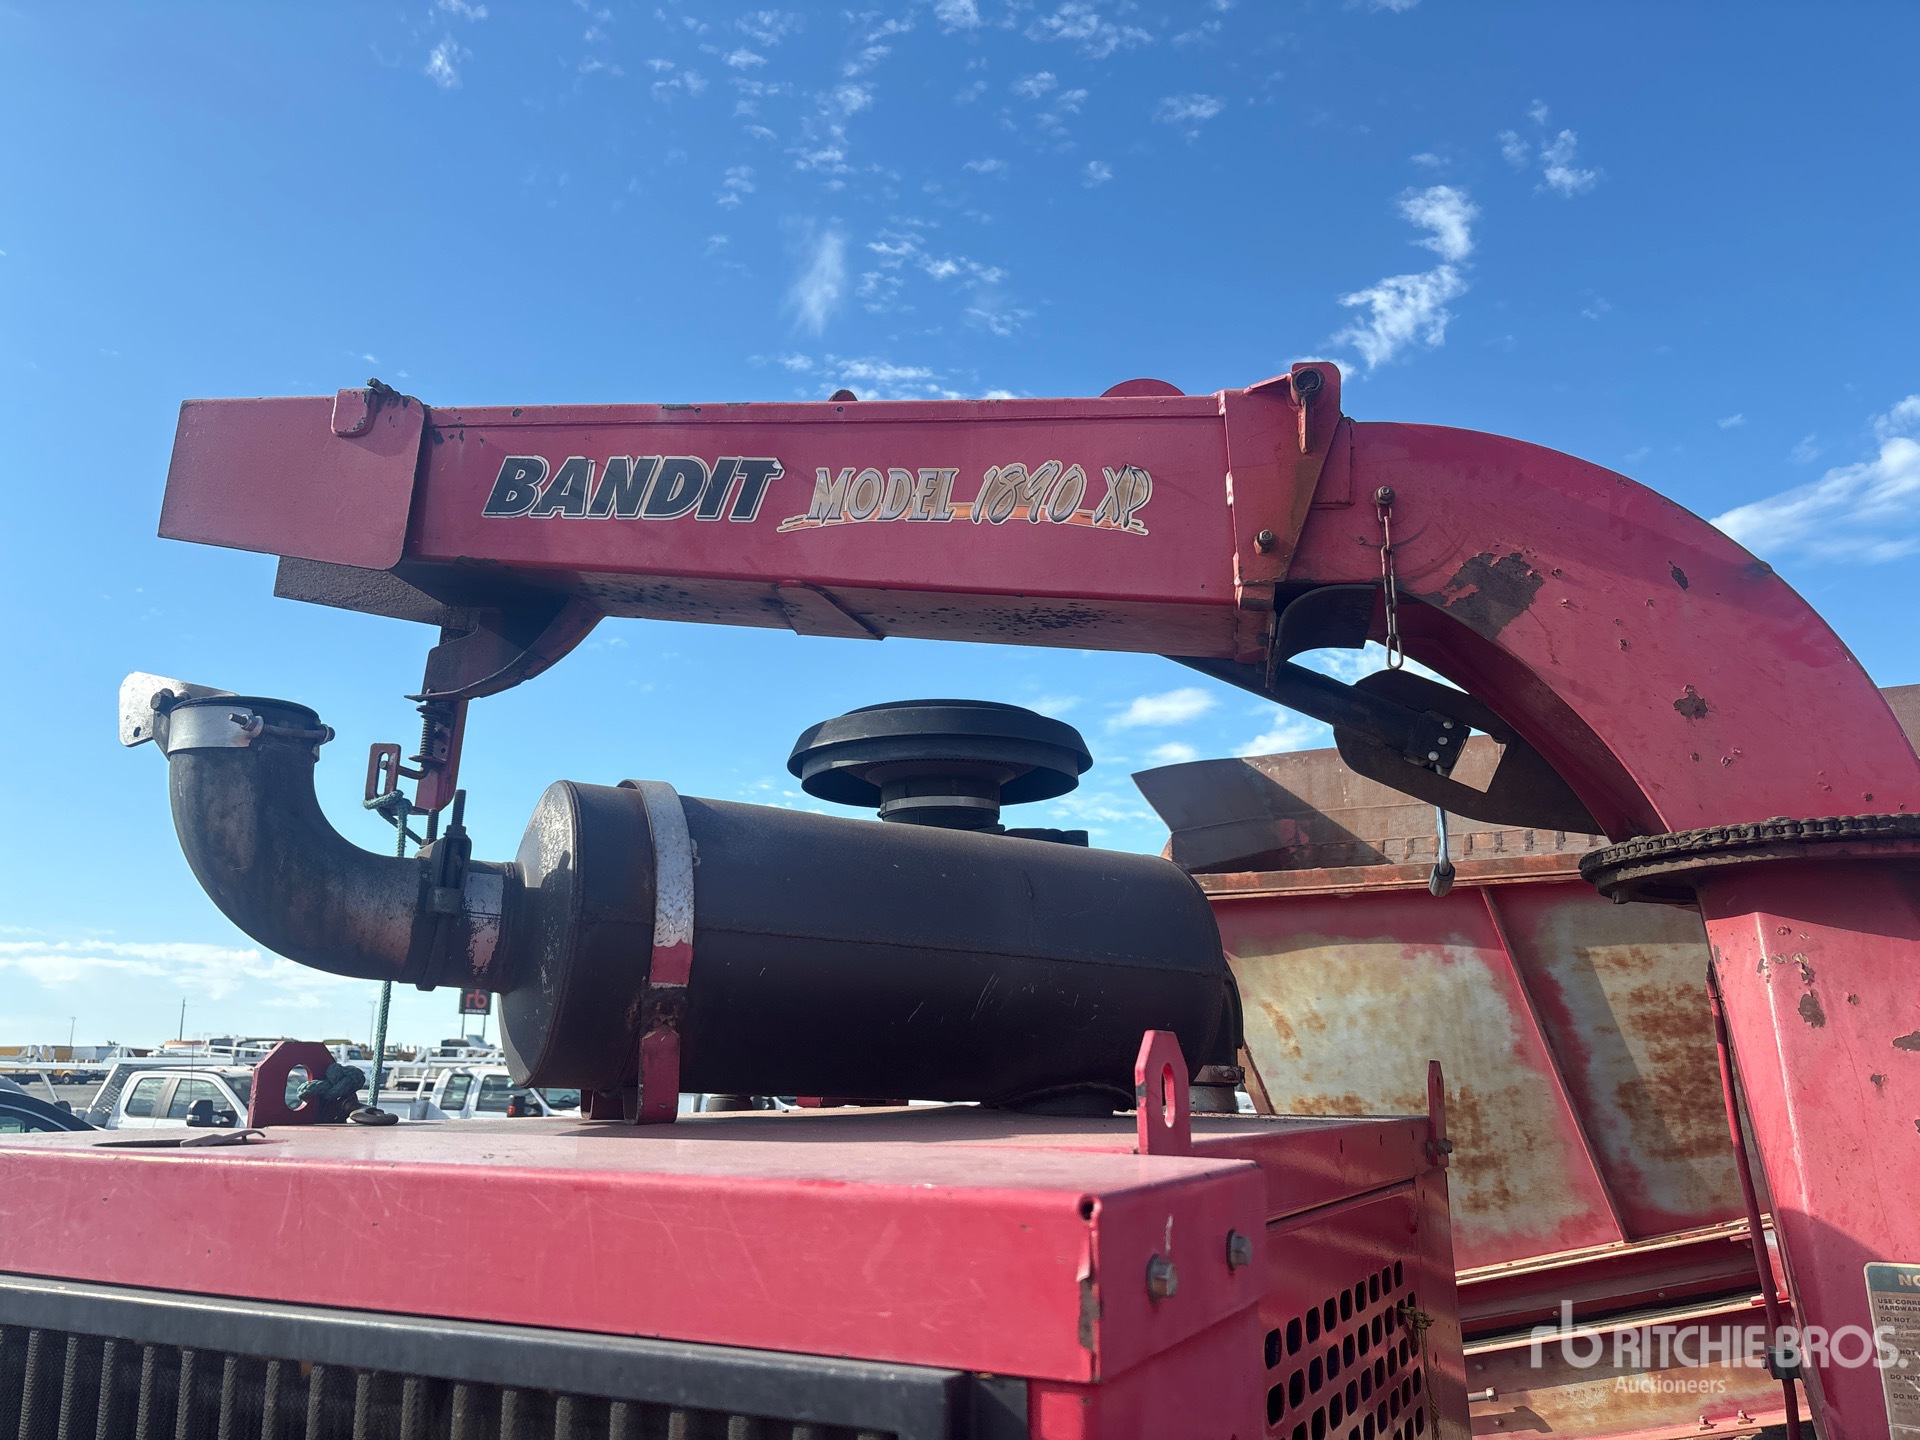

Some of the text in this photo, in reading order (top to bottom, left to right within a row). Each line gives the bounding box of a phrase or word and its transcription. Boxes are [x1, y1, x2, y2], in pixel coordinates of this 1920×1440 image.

[482, 456, 1153, 530] BANDIT MODEL 1890 XP
[466, 989, 487, 1009] rb
[1894, 1316, 1911, 1324] NOT
